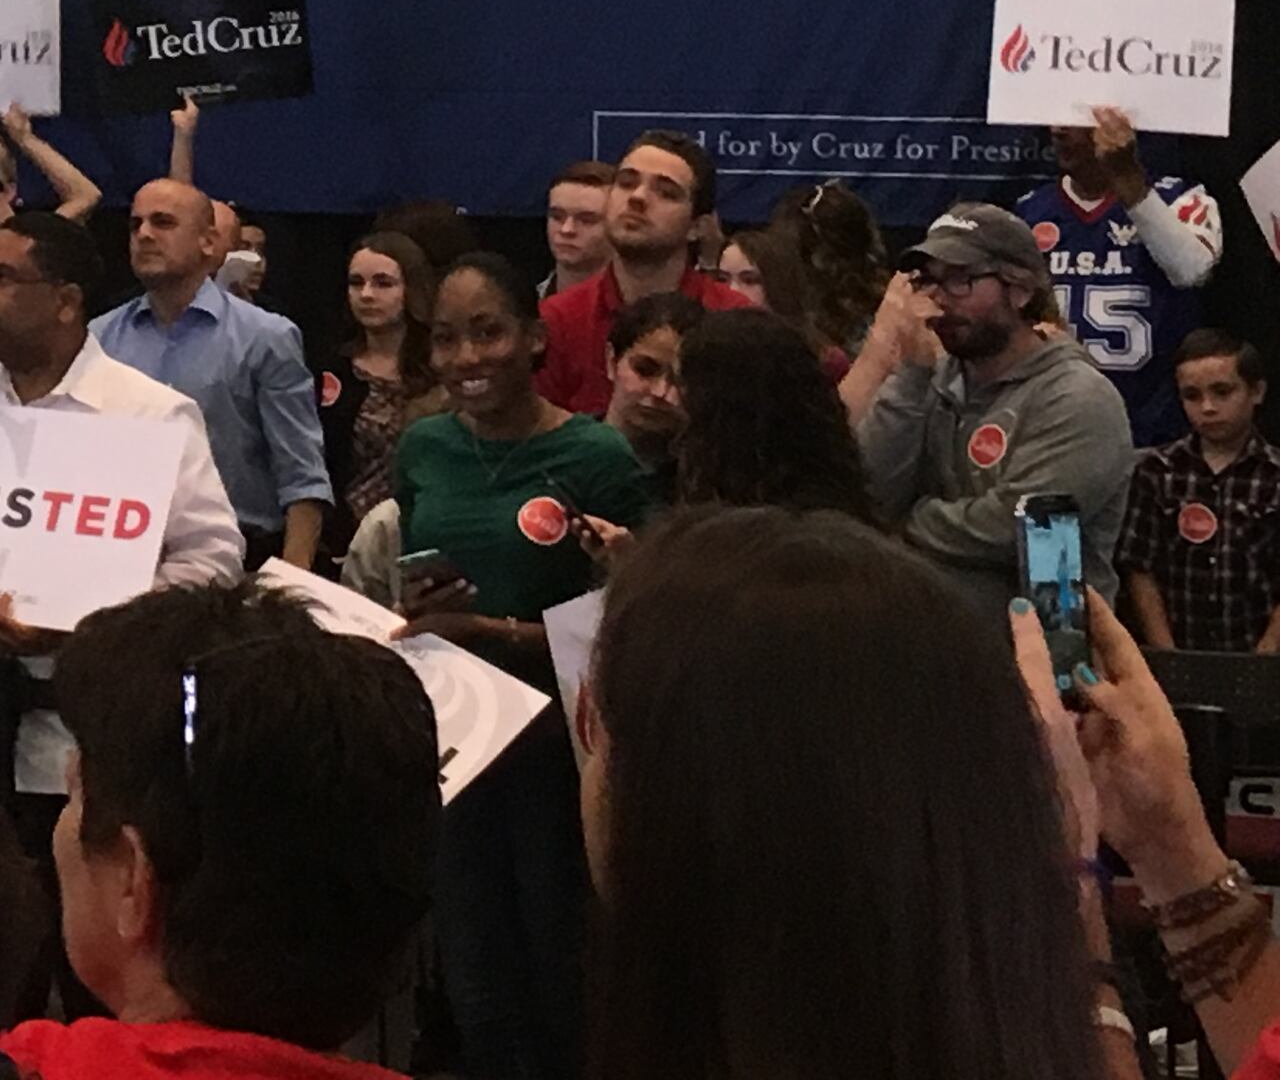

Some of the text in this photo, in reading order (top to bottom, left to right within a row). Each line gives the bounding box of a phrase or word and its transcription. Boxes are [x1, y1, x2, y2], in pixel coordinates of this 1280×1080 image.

[135, 16, 303, 60] TedCruz
[1040, 32, 1223, 81] TedCruz
[717, 129, 761, 157] for
[770, 130, 803, 166] by
[811, 131, 886, 159] Cruz
[893, 133, 940, 160] for
[950, 134, 1057, 162] Preside
[1049, 250, 1133, 276] U.S.A.
